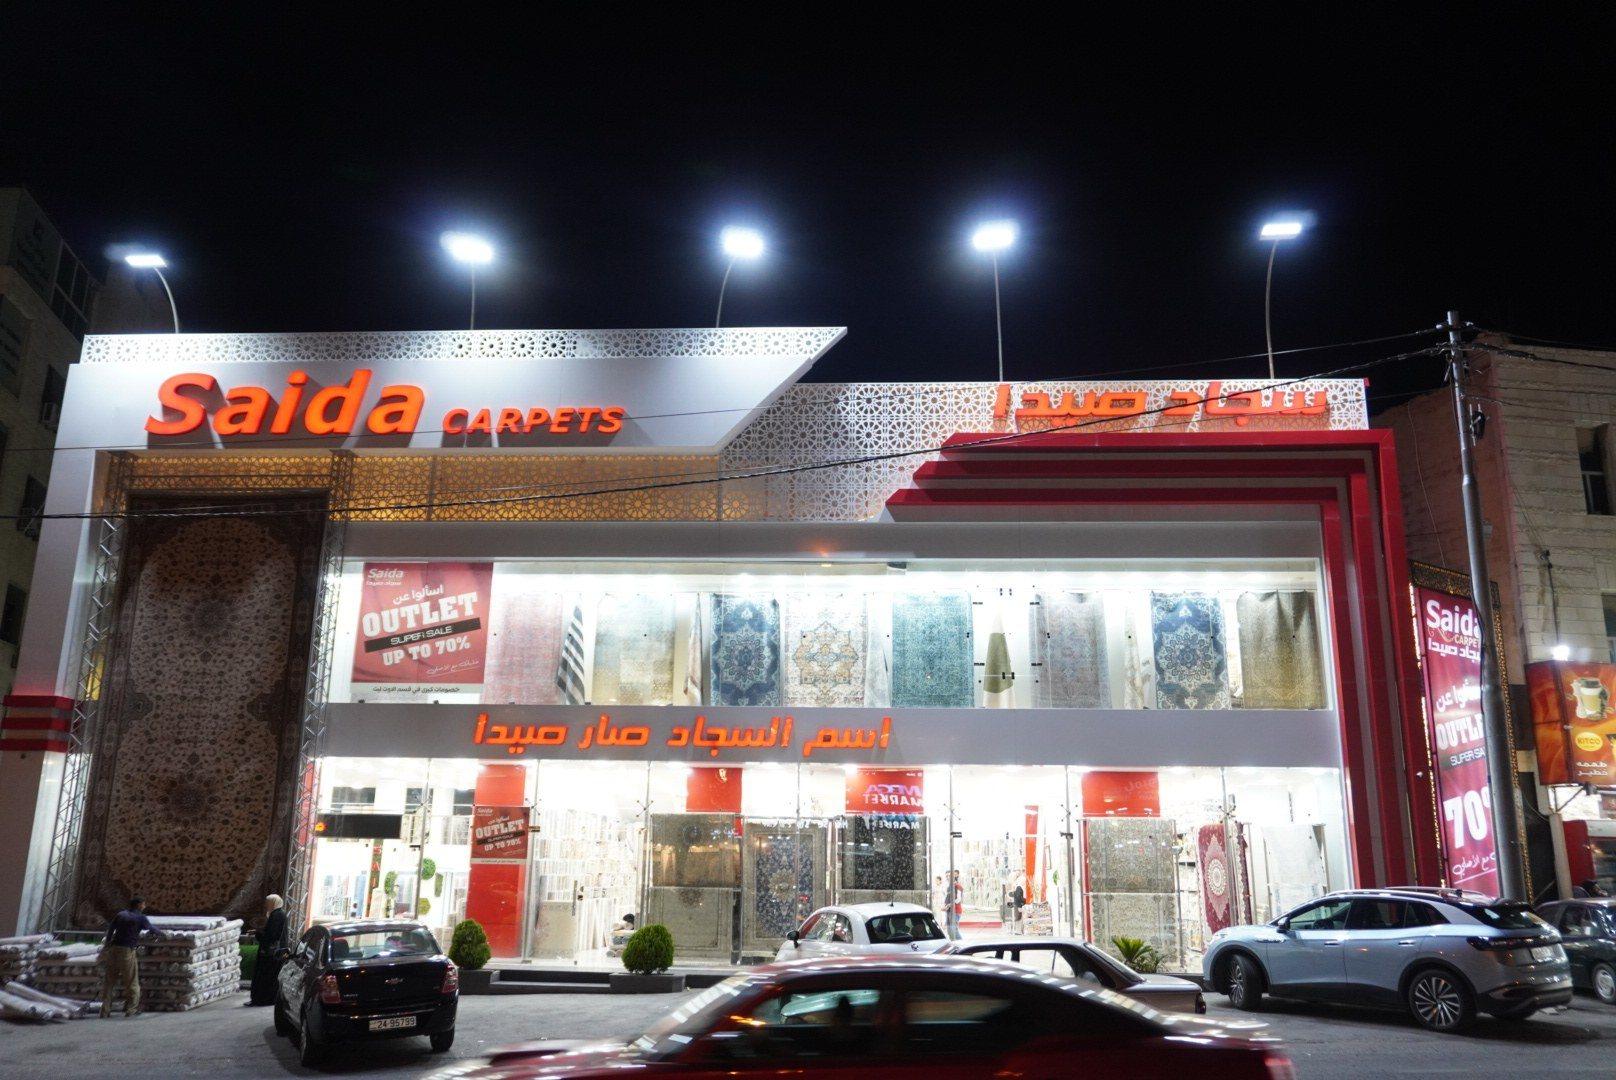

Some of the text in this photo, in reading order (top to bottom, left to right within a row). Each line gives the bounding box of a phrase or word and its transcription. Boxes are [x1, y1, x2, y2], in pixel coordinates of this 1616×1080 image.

[145, 368, 625, 435] Saida CARPETS
[994, 381, 1327, 427] سجاد صيدا
[368, 568, 404, 579] Saida
[393, 585, 444, 605] اسألوا عن
[362, 592, 478, 637] OUTLET
[1426, 600, 1481, 638] Saida
[390, 626, 453, 645] SUPER SALE
[382, 635, 471, 666] UP TO 70%
[1428, 638, 1457, 657] صيدا
[1436, 693, 1453, 712] عن
[474, 712, 892, 756] اسم السجاد صار صيدا
[1450, 751, 1475, 766] SUPER
[475, 819, 524, 839] OUTLET
[484, 843, 494, 851] UP
[506, 838, 522, 847] 70%
